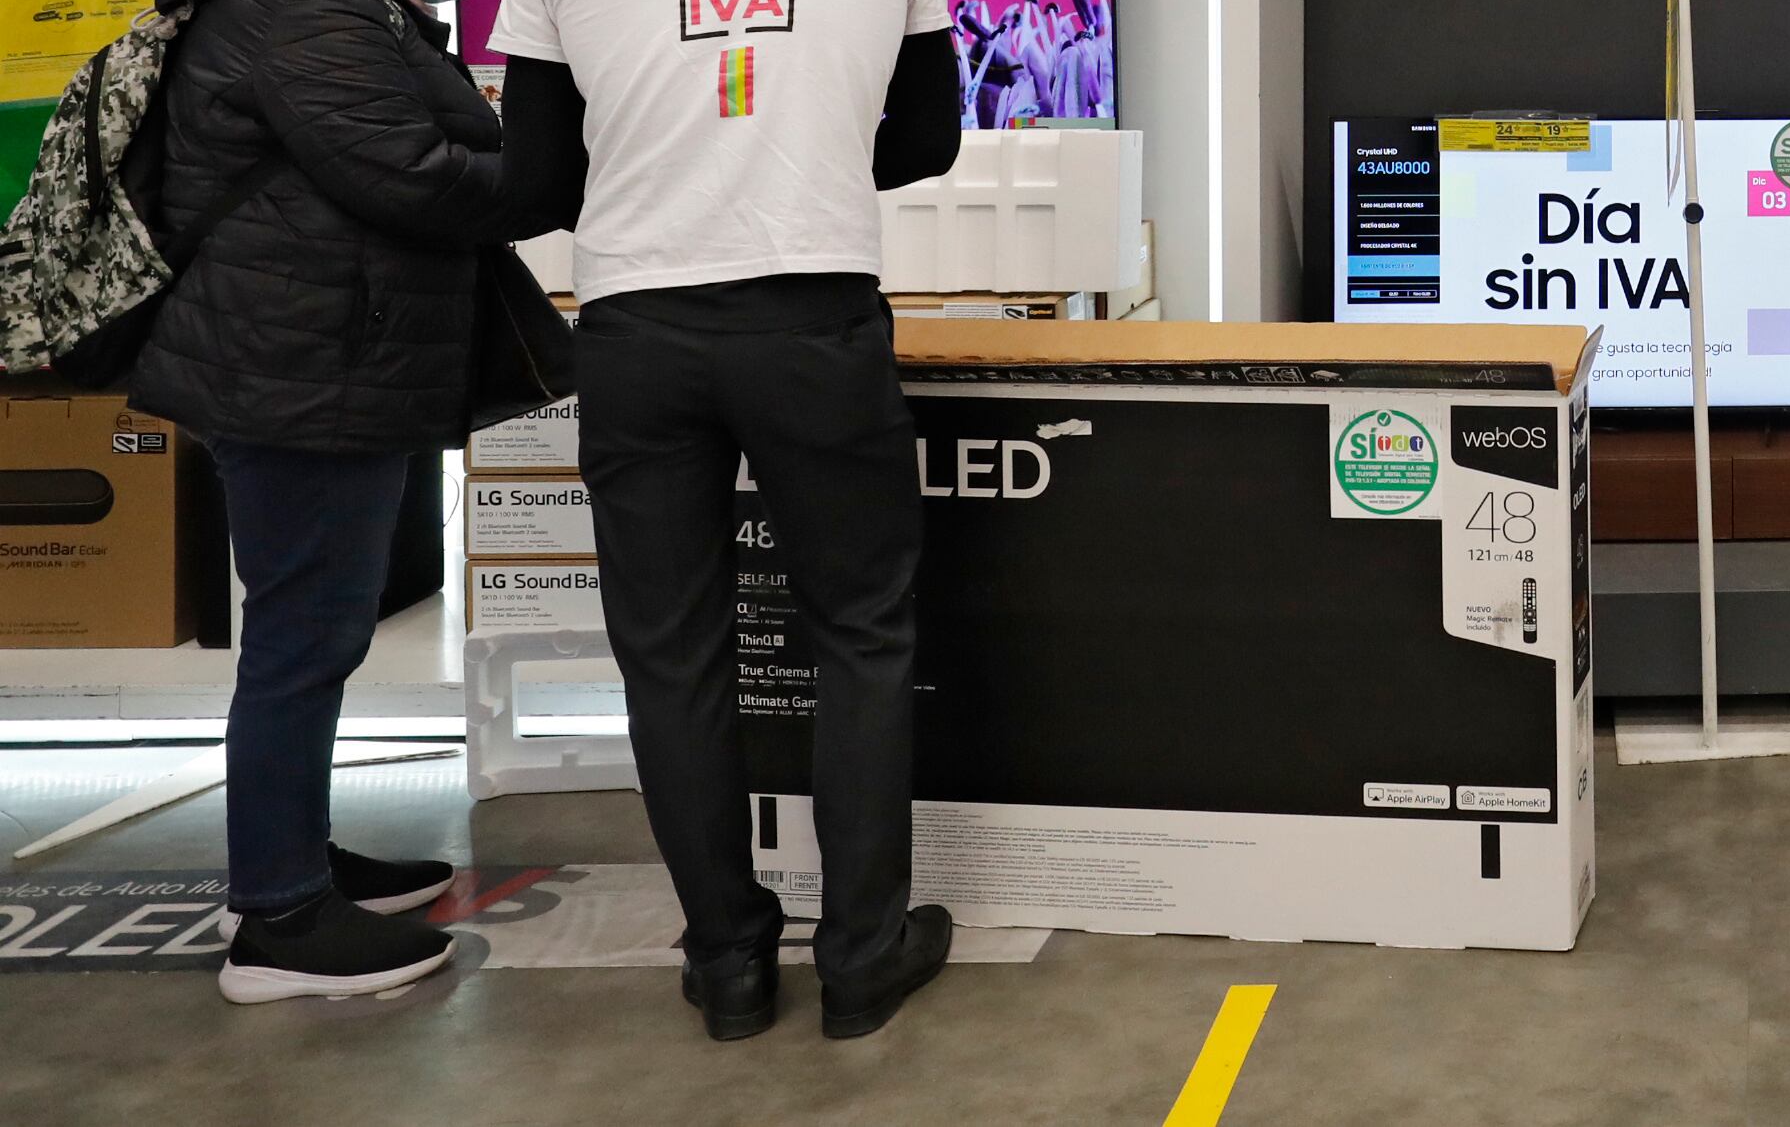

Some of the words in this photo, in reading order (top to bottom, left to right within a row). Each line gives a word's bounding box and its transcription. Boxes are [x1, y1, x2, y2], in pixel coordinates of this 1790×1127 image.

[1496, 125, 1514, 135] 24
[1546, 125, 1561, 135] 19
[1357, 148, 1383, 157] Crystal
[1357, 161, 1430, 175] 43AU8000
[1752, 177, 1766, 186] Dic
[1762, 191, 1787, 210] 03
[1538, 187, 1641, 244] Día
[1485, 252, 1577, 310] sin
[1598, 258, 1691, 310] IVA
[1606, 342, 1644, 357] gusta
[1647, 342, 1659, 353] la
[1662, 340, 1732, 356] tecnogía
[1592, 368, 1624, 382] gran
[1627, 366, 1713, 381] oportunid!
[1350, 428, 1377, 460] SÍ
[1377, 434, 1424, 452] tdt
[1462, 426, 1548, 450] webOS
[477, 491, 502, 506] LG
[510, 490, 568, 506] Sound
[1465, 491, 1537, 544] 48
[51, 544, 77, 556] Bar
[1468, 549, 1492, 562] 121
[1515, 550, 1534, 562] 48
[481, 573, 506, 589] LG
[514, 573, 572, 589] Sound
[1466, 614, 1486, 623] Magic
[738, 634, 773, 646] ThinQ
[738, 664, 764, 676] True
[767, 665, 811, 678] Cinema
[738, 694, 789, 707] Ultimate
[1387, 793, 1414, 806] Apple
[1415, 794, 1446, 807] AirPlay
[1479, 797, 1505, 809] Apple
[1506, 797, 1547, 809] HomeKit
[57, 881, 104, 897] de
[102, 880, 187, 896] Auto
